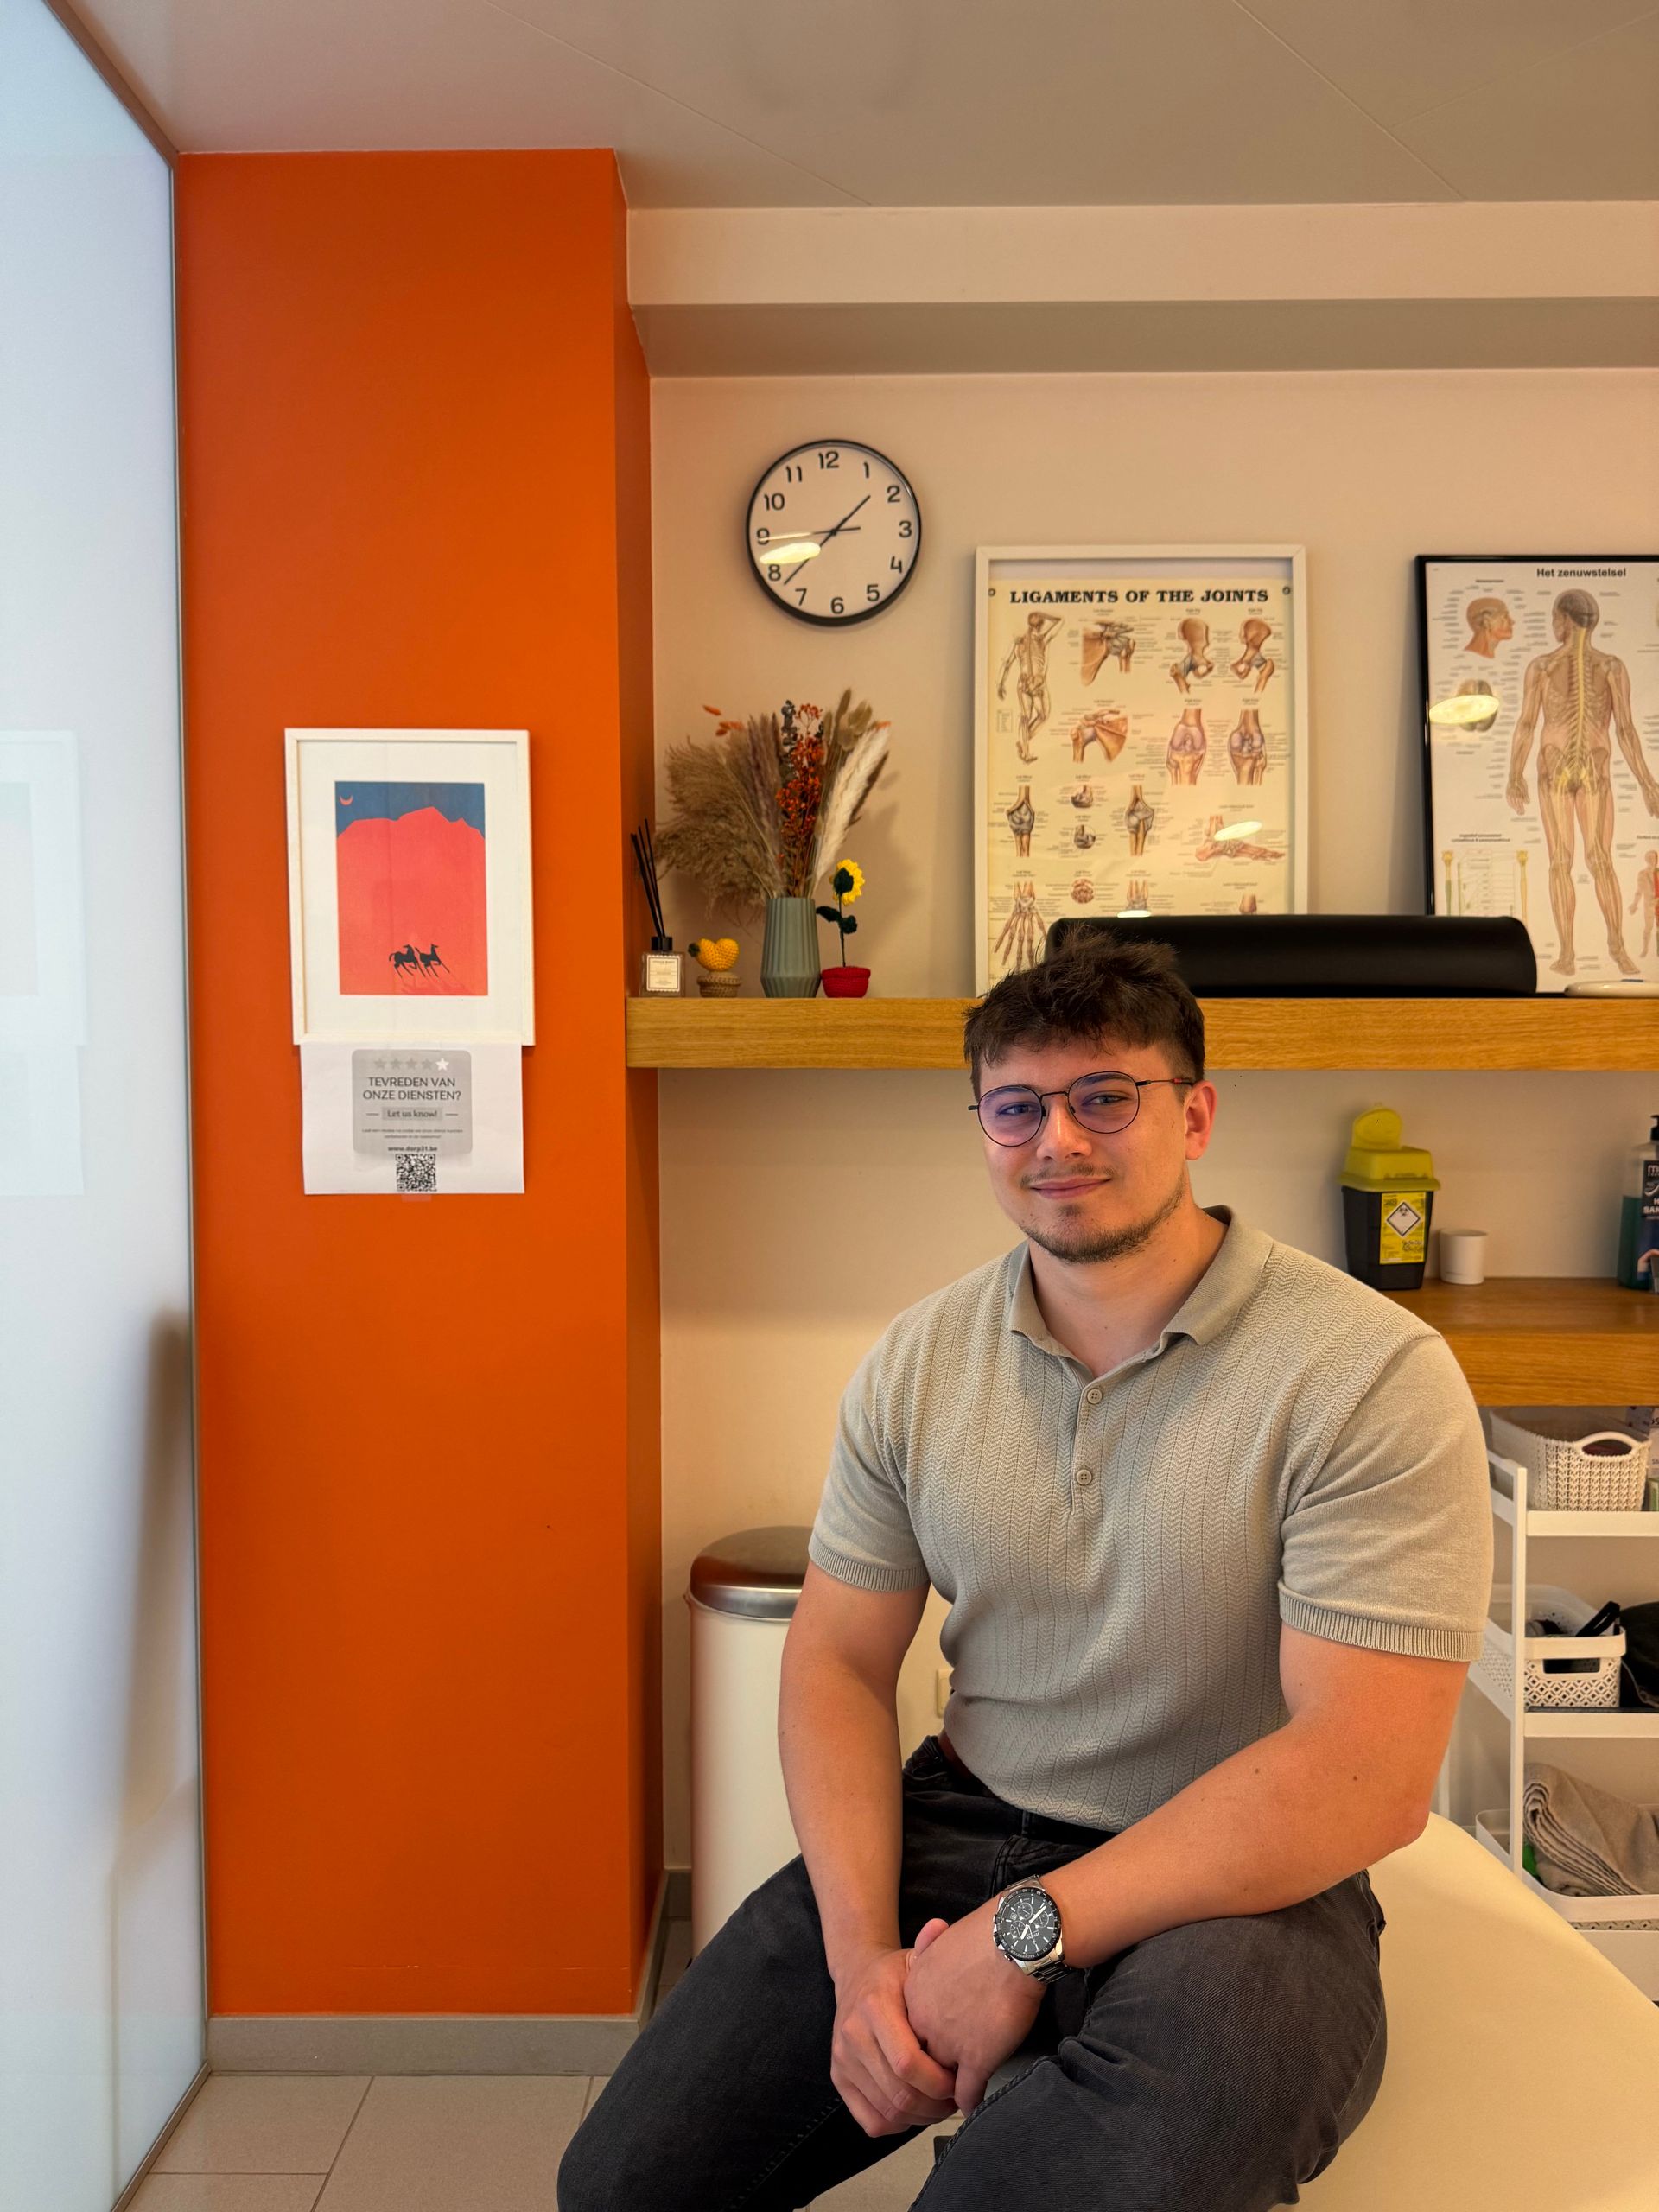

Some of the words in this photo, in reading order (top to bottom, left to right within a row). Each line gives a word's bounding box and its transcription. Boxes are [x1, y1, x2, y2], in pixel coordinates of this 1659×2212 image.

[817, 451, 839, 469] 12
[785, 466, 803, 483] 11
[863, 462, 870, 479] 1
[764, 493, 785, 512] 10
[887, 485, 900, 503] 2
[756, 528, 770, 545] 9
[899, 520, 912, 538] 3
[767, 564, 781, 582] 8
[890, 556, 903, 574] 4
[1536, 568, 1554, 577] Het
[1557, 568, 1626, 578] zenuwstelsel
[795, 588, 808, 607] 7
[866, 584, 880, 602] 5
[1010, 590, 1118, 603] LIGAMENTS
[1125, 590, 1149, 602] OF
[1156, 590, 1194, 602] THE
[1200, 589, 1268, 602] JOINTS
[830, 597, 844, 614] 6
[368, 1077, 428, 1087] TEVREDEN
[431, 1077, 455, 1087] VAN
[363, 1090, 395, 1100] ONZE
[398, 1090, 461, 1101] DIENSTEN?
